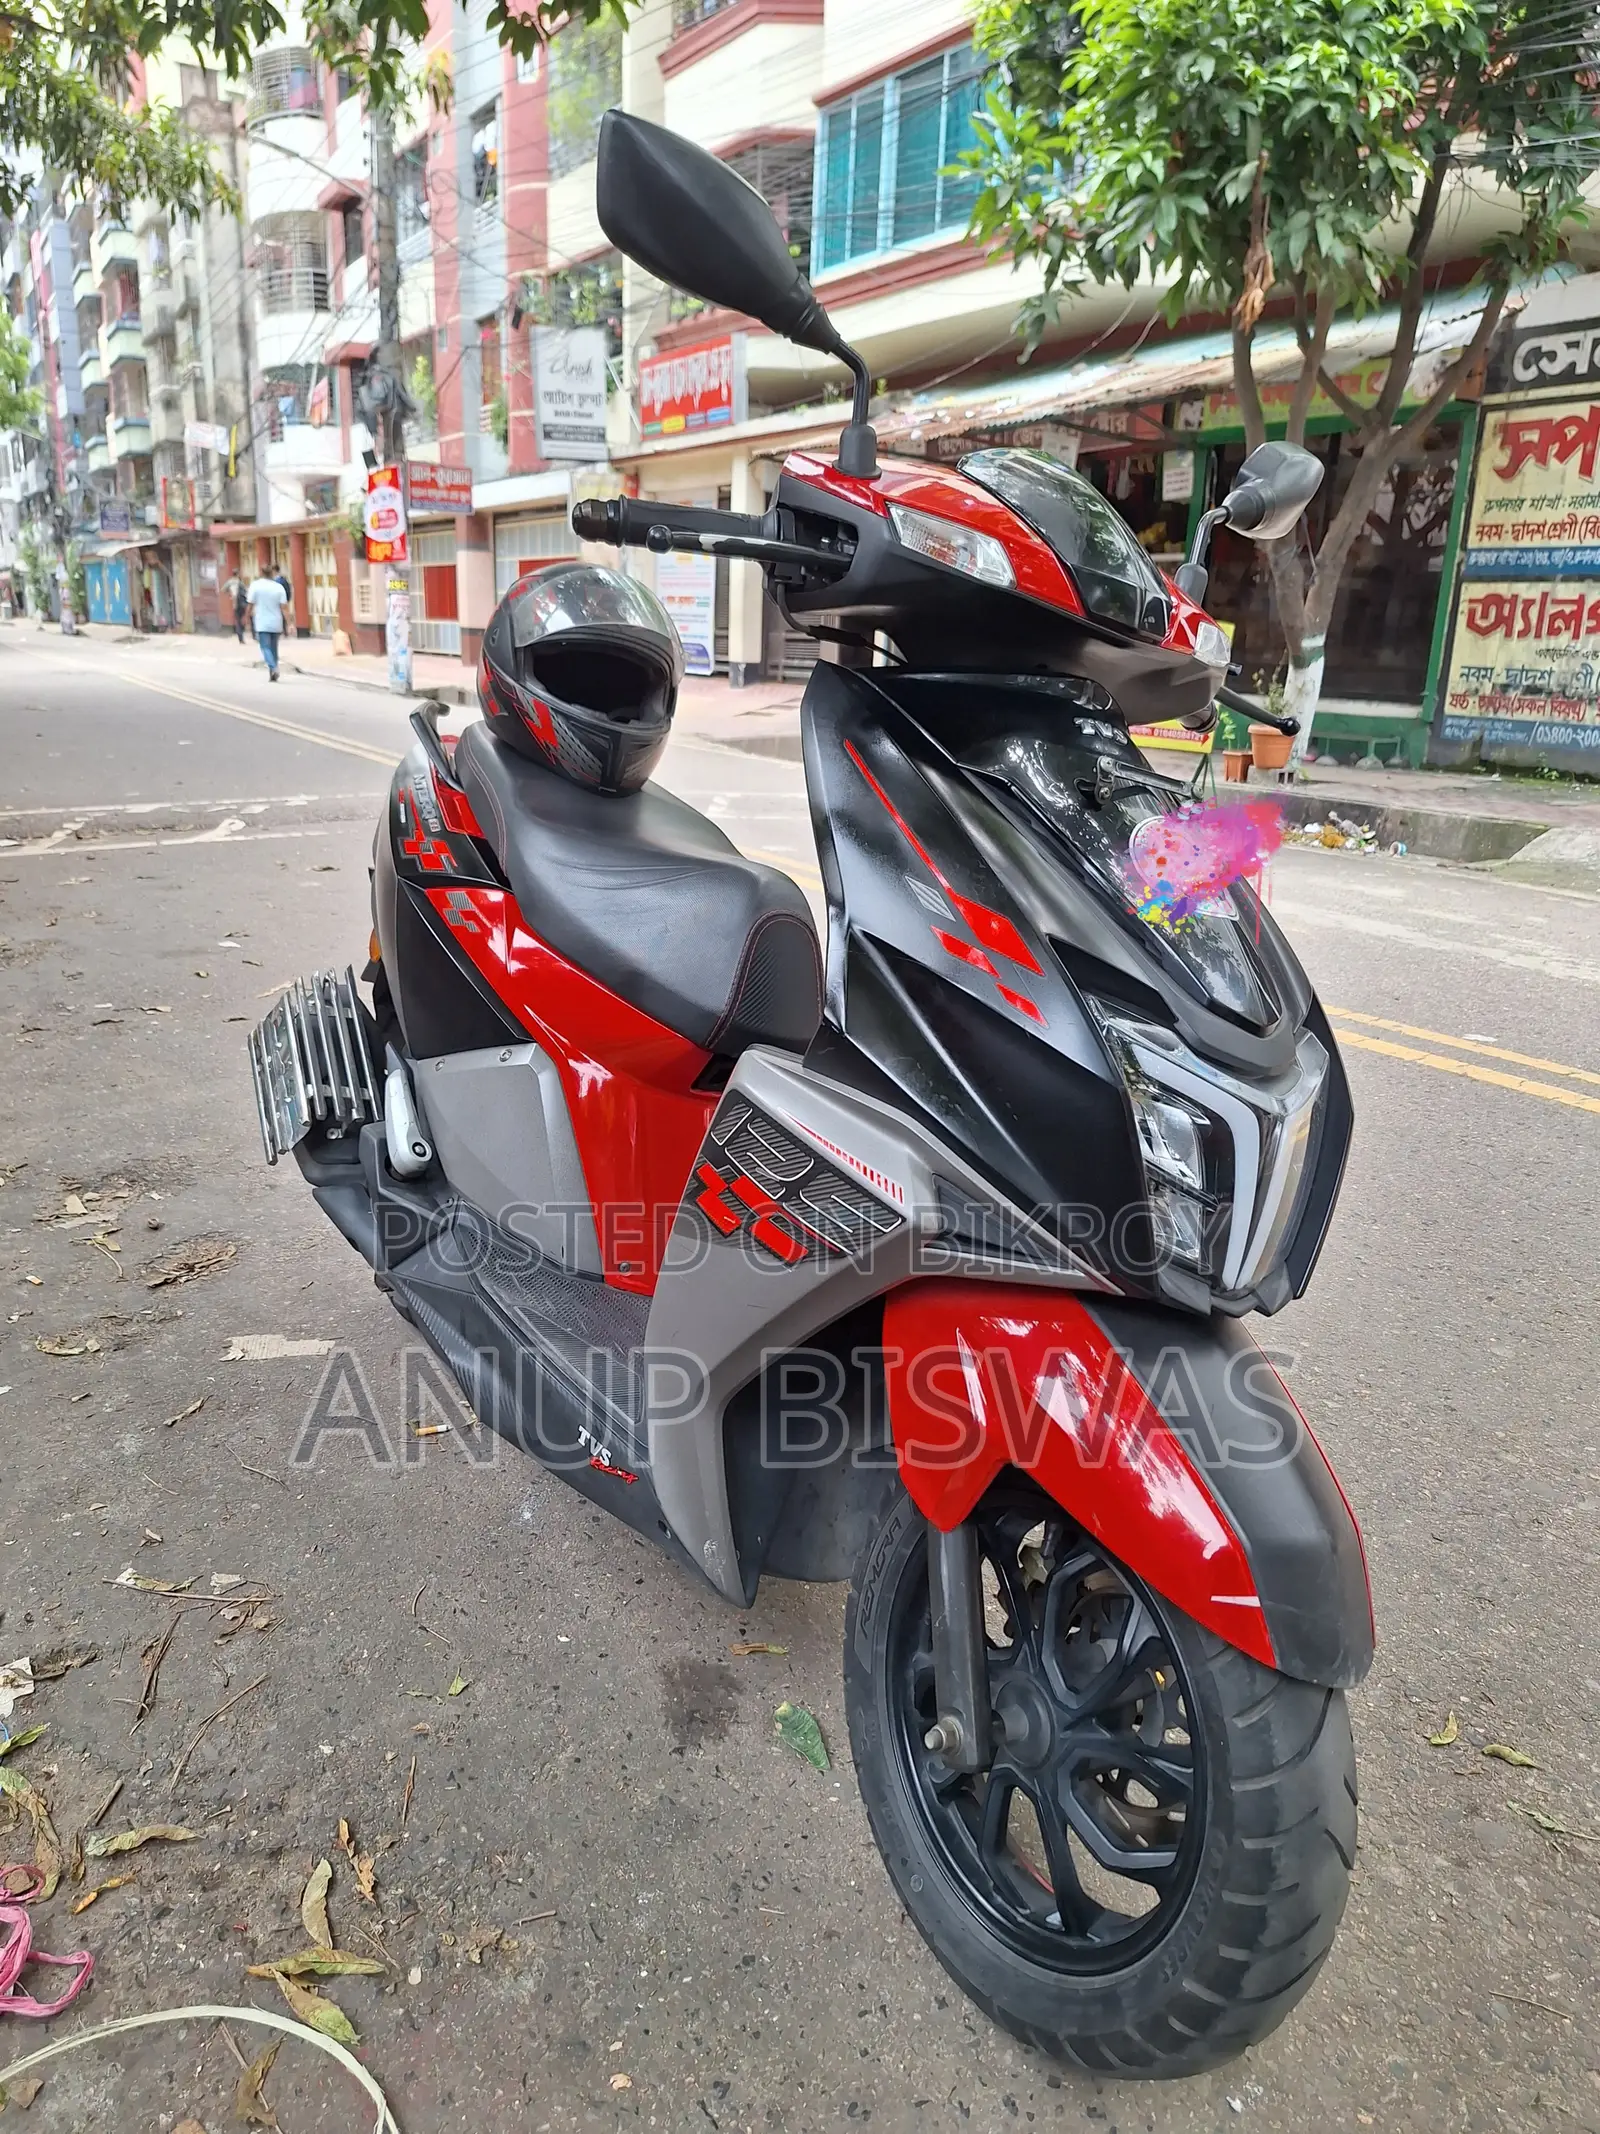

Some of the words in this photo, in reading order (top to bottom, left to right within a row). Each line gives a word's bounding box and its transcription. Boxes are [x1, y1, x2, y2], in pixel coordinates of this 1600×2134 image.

[1475, 522, 1504, 542] নবম
[1460, 665, 1495, 683] নবম
[577, 1424, 612, 1467] TVS
